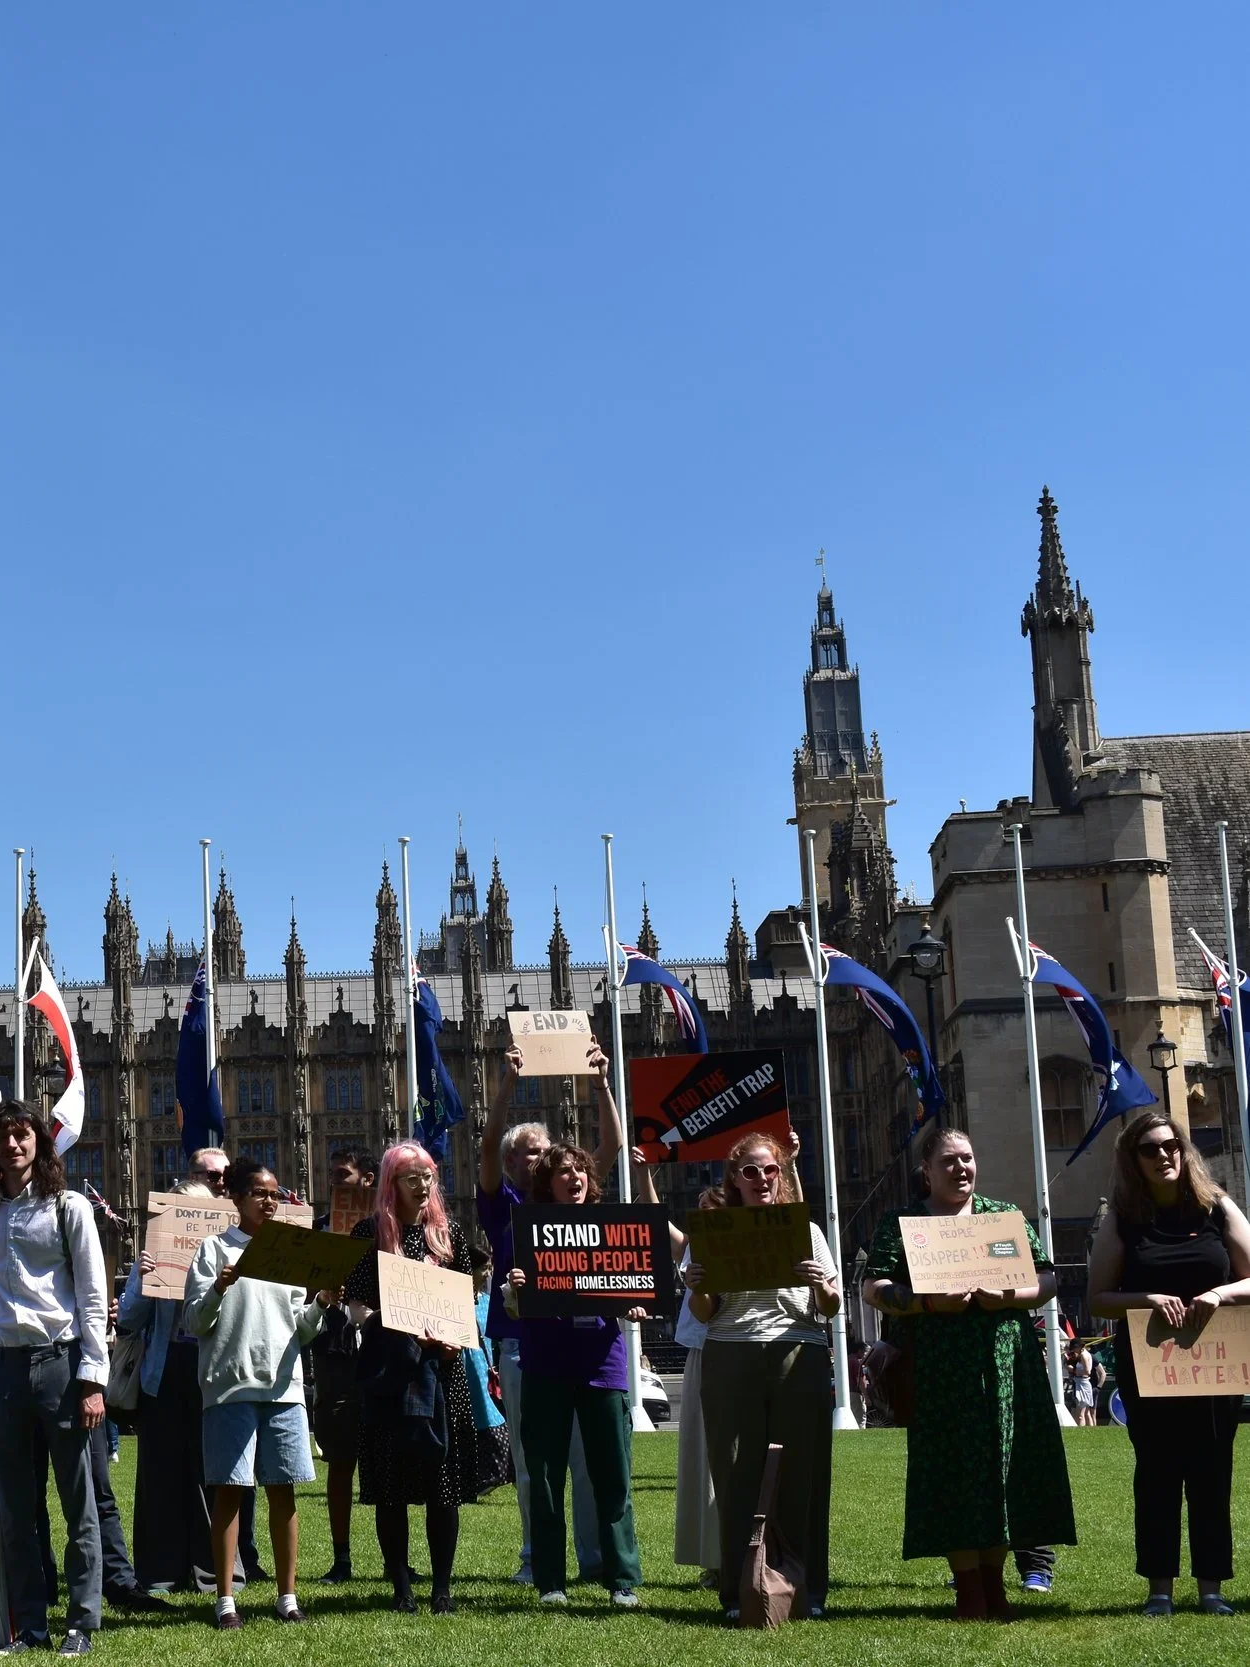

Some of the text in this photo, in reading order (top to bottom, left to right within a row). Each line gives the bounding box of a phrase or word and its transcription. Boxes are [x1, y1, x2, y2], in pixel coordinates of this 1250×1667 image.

[533, 1013, 569, 1031] END
[669, 1067, 730, 1118] END THE
[681, 1063, 775, 1137] BENEFIT TRAP
[176, 1208, 202, 1219] DON'T
[204, 1211, 221, 1220] LET
[938, 1216, 958, 1227] LET
[186, 1223, 199, 1232] BE
[532, 1223, 651, 1247] I STAND WITH
[534, 1251, 653, 1272] YOUNG PEOPLE
[390, 1262, 430, 1293] SAFE
[537, 1275, 655, 1290] FACING HOMELESSNESS
[934, 1281, 947, 1291] WE
[388, 1287, 466, 1321] AFFORDABLE
[389, 1304, 445, 1338] HOUSING
